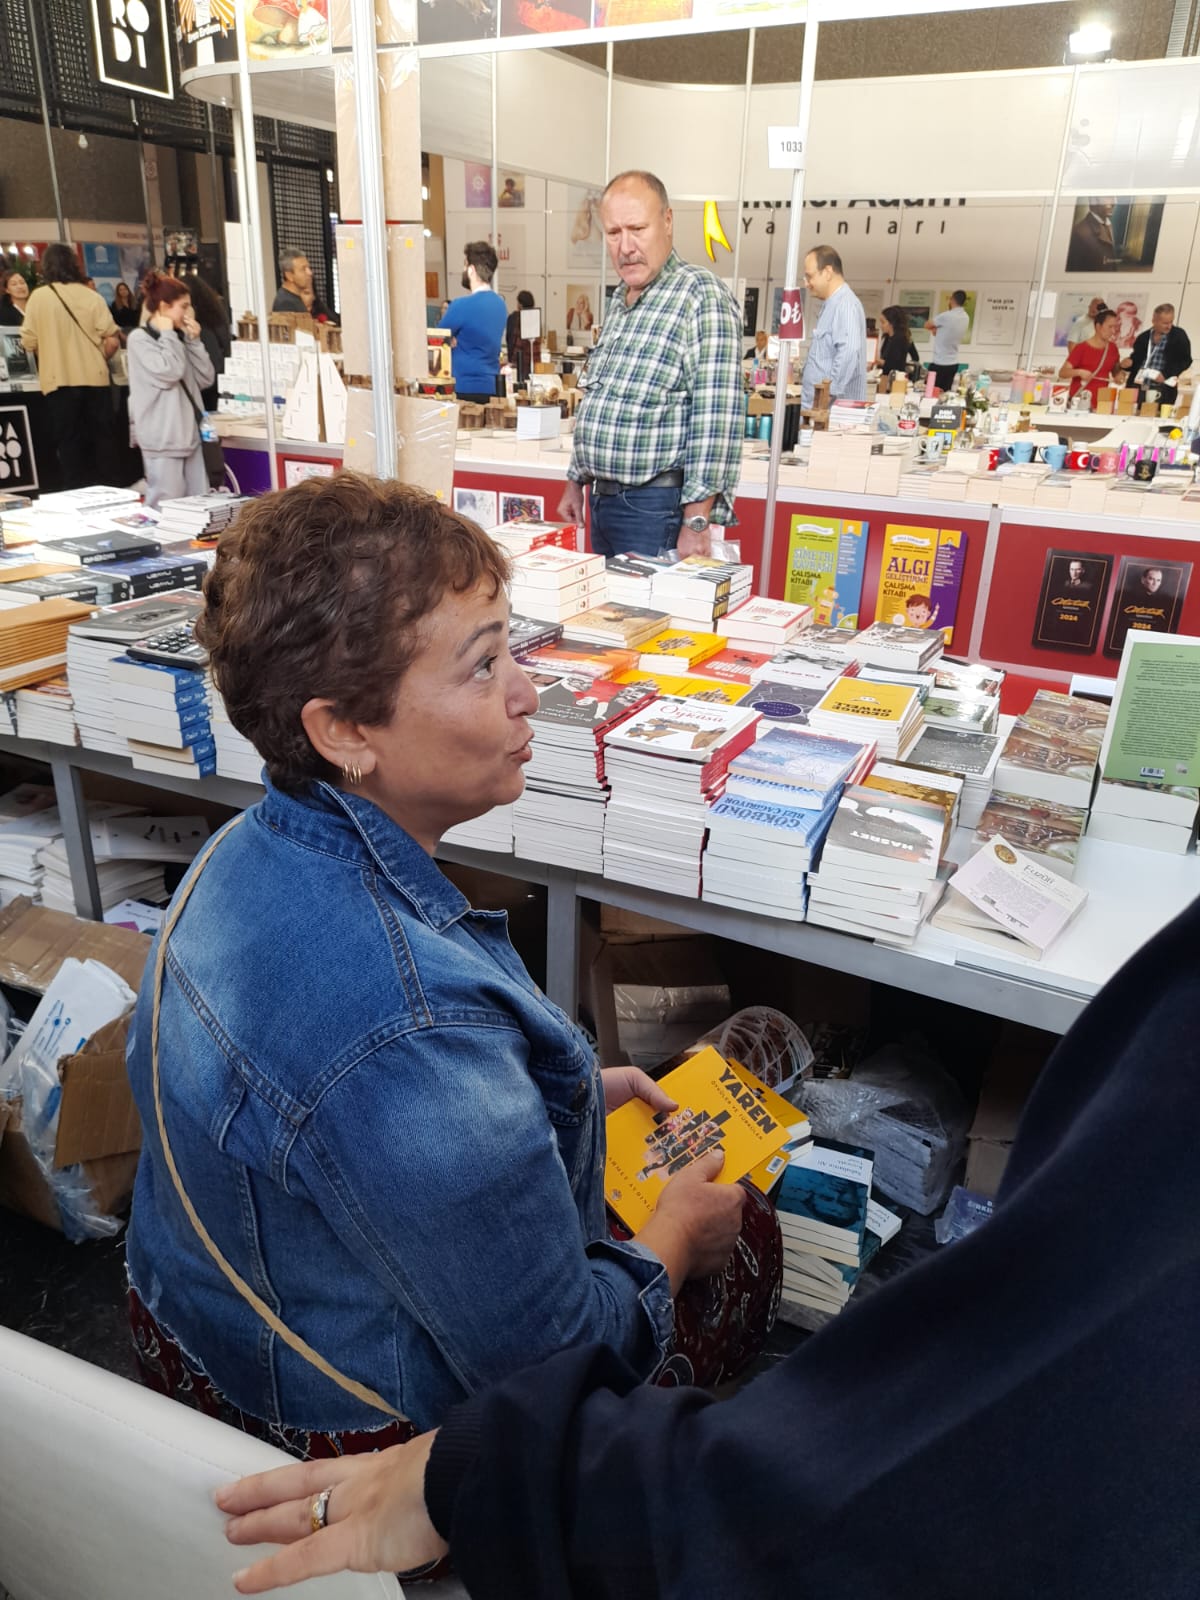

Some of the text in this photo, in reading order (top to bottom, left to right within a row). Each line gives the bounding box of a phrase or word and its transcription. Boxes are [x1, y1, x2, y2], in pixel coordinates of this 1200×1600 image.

[780, 141, 803, 153] 1033
[742, 216, 946, 235] Yaınları
[887, 556, 931, 576] ALGI
[1059, 613, 1079, 623] 2024
[831, 706, 891, 718] GEORGE
[834, 701, 892, 713] ORWELL
[849, 830, 915, 851] HASRET
[718, 1065, 779, 1135] YAREN
[608, 1156, 629, 1181] AHMET
